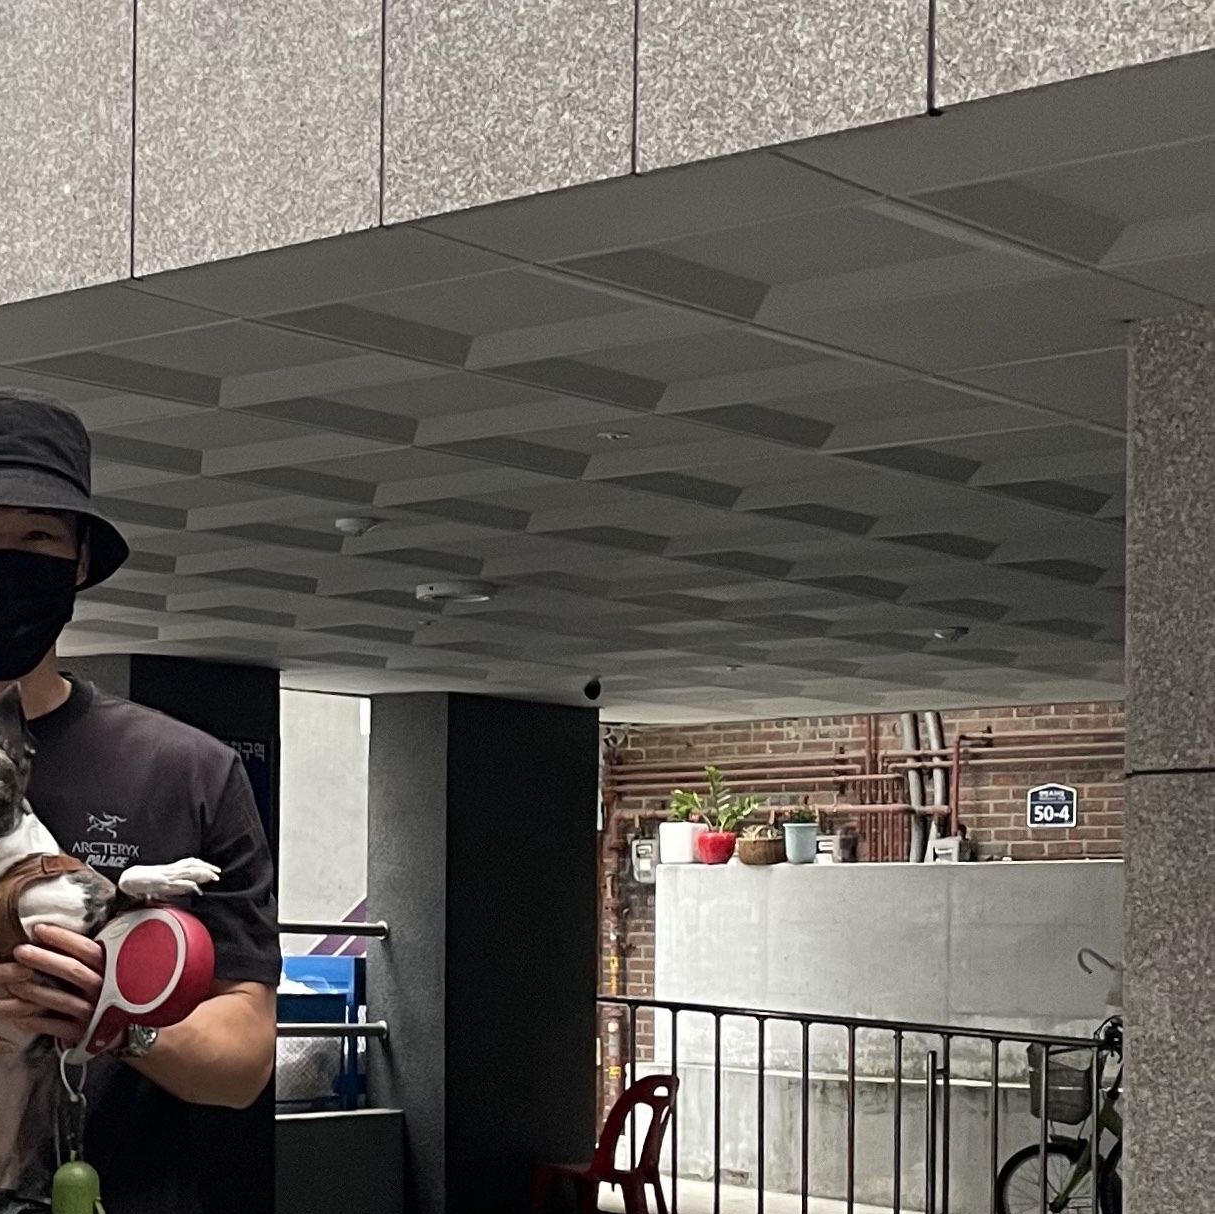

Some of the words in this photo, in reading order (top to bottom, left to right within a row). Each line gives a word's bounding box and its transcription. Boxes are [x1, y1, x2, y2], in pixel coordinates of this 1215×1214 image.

[1033, 804, 1070, 822] 50-4
[71, 841, 140, 858] ARCTERYX
[86, 854, 129, 868] PALACE
